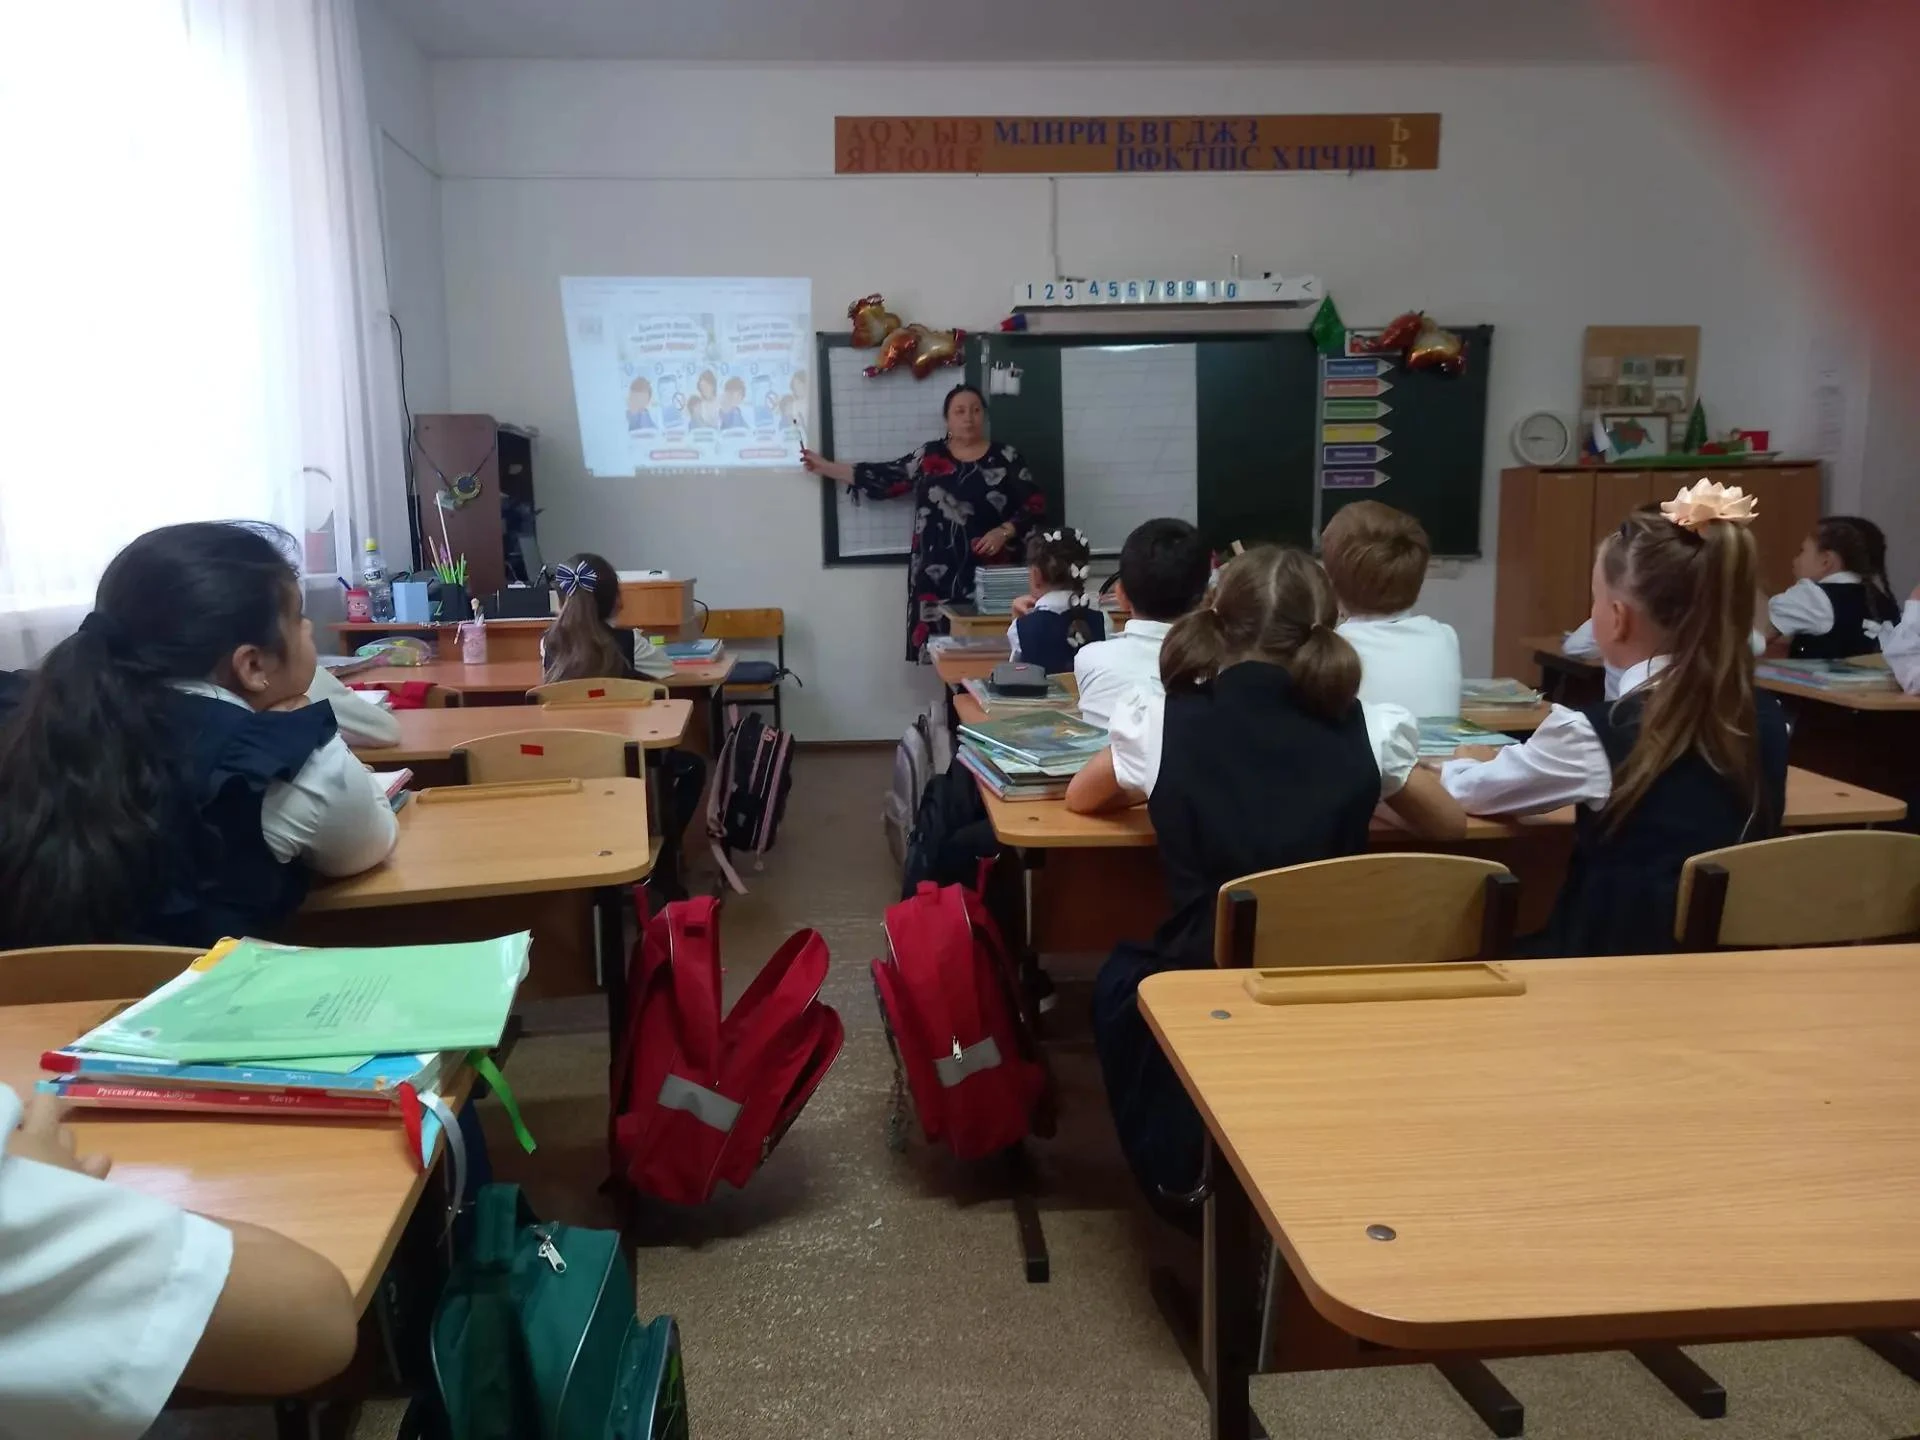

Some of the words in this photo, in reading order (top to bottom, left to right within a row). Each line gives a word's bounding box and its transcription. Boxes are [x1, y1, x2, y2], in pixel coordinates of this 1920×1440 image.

[1026, 283, 1033, 300] 1
[1044, 283, 1055, 300] 2
[1064, 284, 1074, 300] 3
[1089, 280, 1099, 297] 4
[1109, 281, 1118, 297] 5
[1128, 280, 1137, 297] 6
[1148, 279, 1156, 297] 7
[1166, 281, 1176, 297] 8
[1185, 281, 1194, 296] 9
[96, 1087, 134, 1097] Русский
